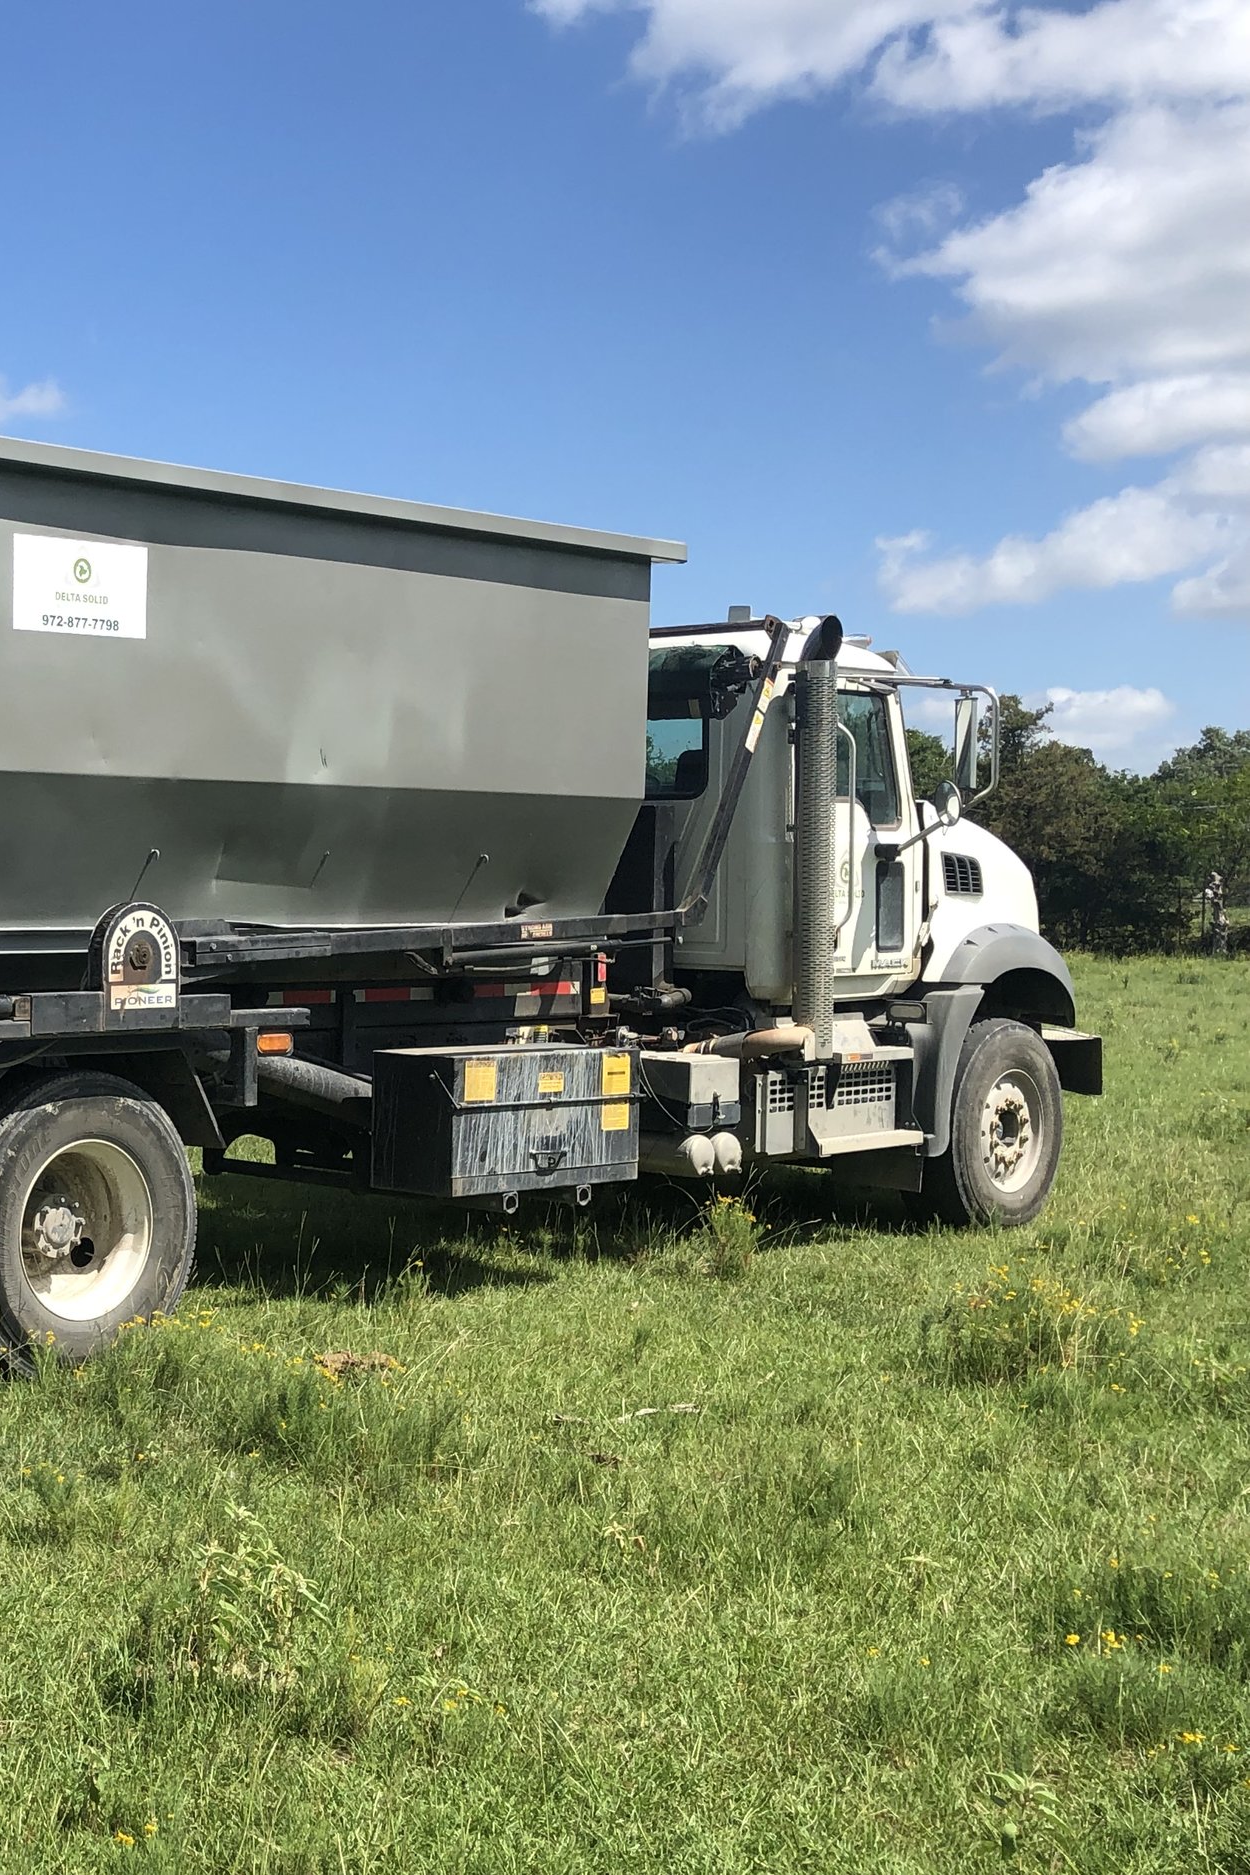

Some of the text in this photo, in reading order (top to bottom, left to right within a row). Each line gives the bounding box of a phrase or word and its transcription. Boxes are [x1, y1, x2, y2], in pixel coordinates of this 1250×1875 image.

[55, 591, 109, 605] DELTA SOLID
[42, 614, 120, 632] 972-877-7798
[110, 925, 131, 975] Rack
[149, 916, 173, 976] Pinion
[870, 959, 909, 971] MACK
